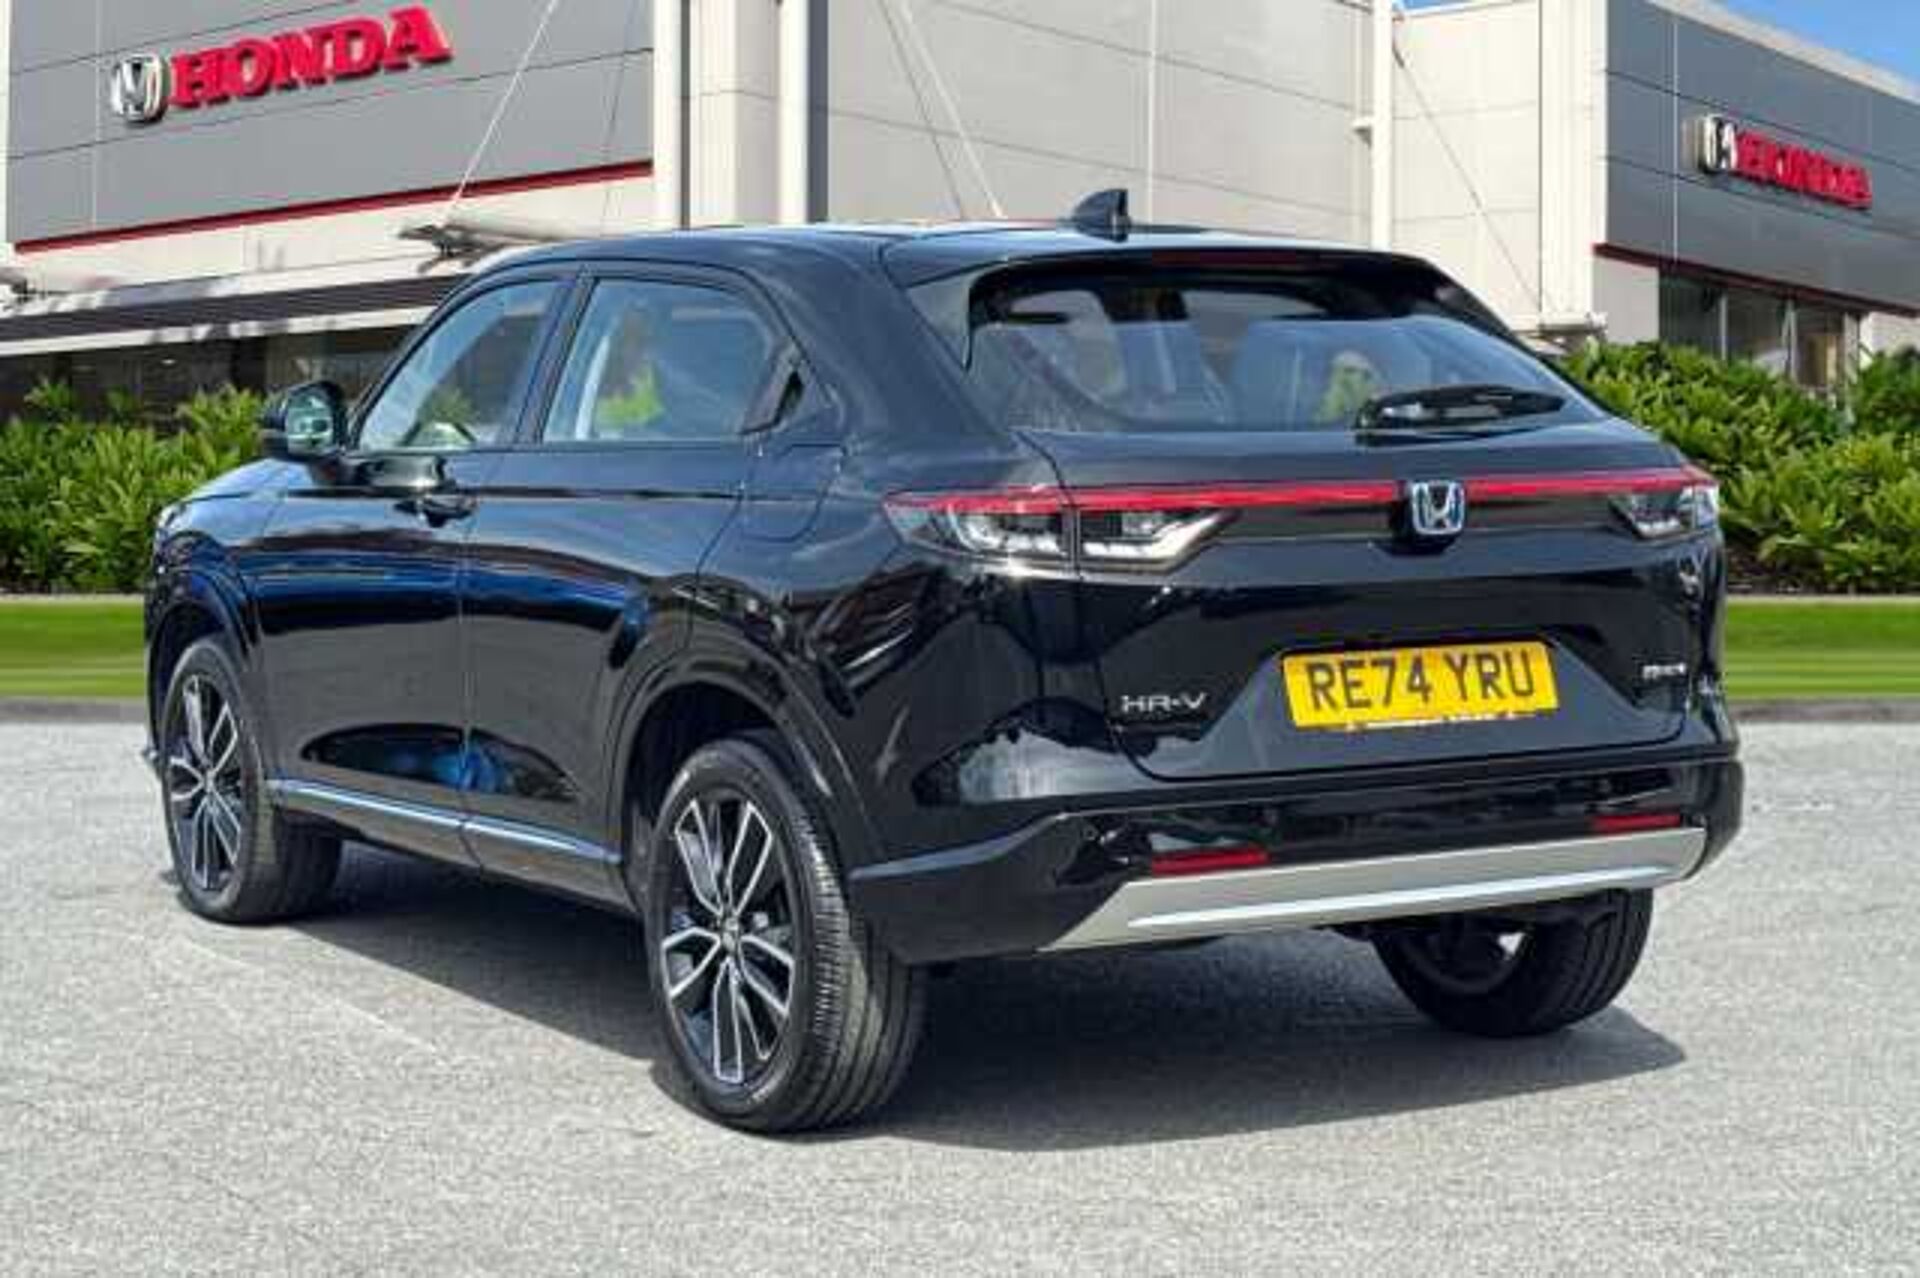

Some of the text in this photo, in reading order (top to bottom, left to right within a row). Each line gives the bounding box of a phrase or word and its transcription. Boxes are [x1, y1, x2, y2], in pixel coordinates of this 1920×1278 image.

[169, 4, 453, 109] HONDA
[1121, 692, 1207, 712] HR-V
[1306, 650, 1534, 711] RE74 YRU
